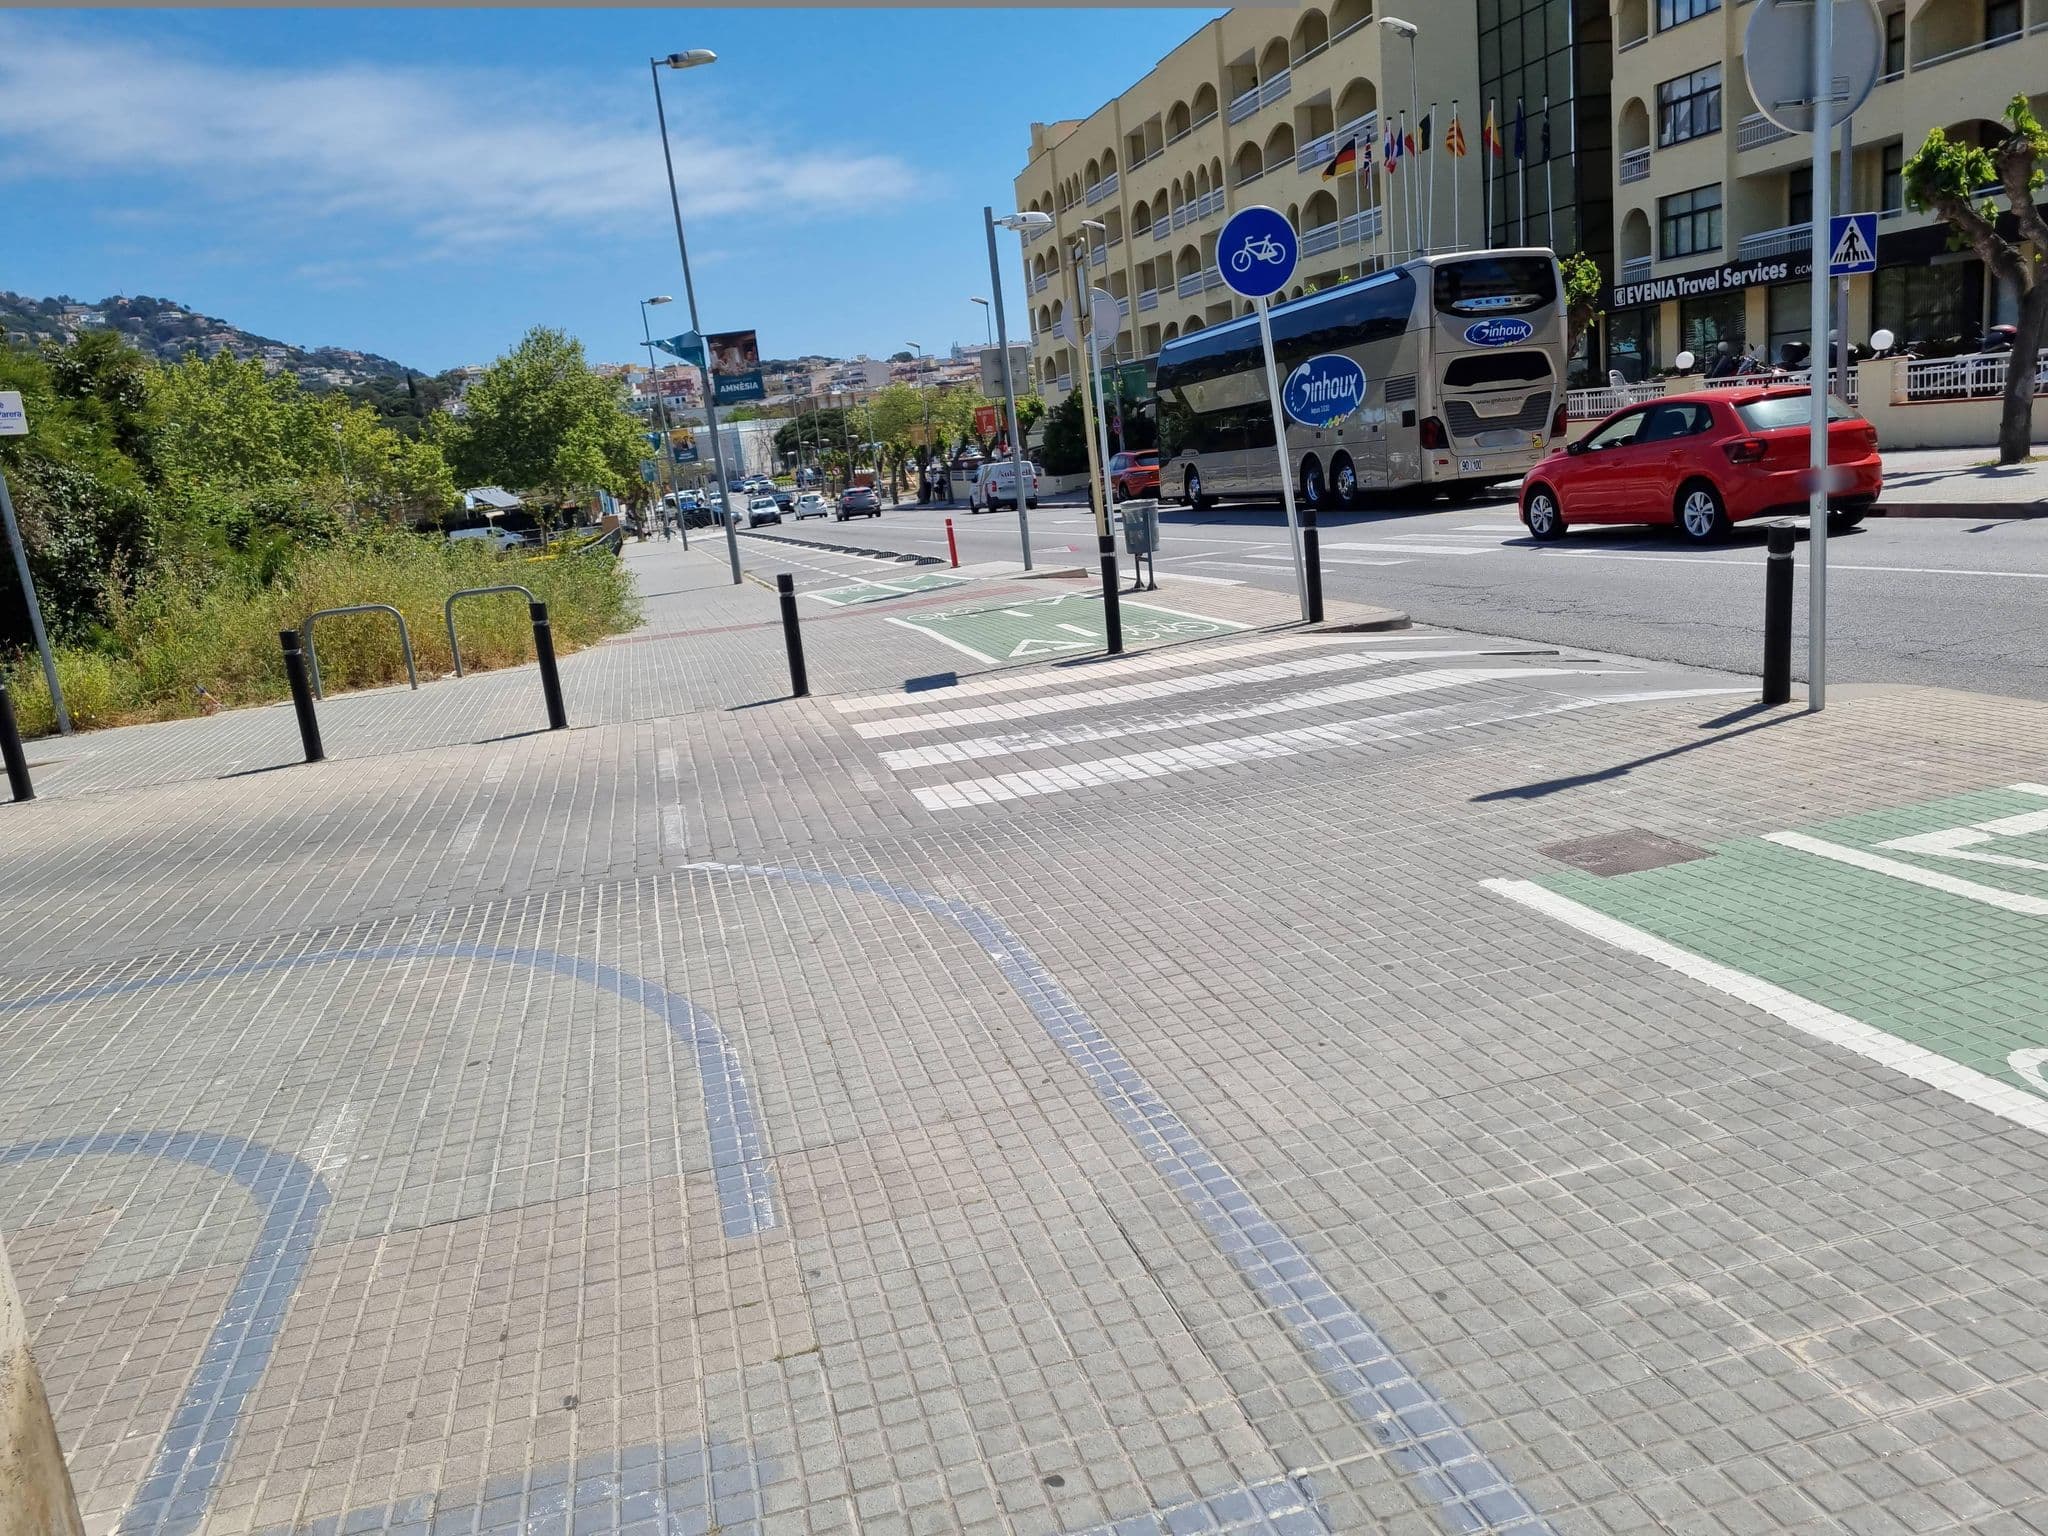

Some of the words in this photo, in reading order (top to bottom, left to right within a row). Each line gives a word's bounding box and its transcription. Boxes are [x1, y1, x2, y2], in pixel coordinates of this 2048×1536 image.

[1627, 279, 1676, 304] EVENIA
[1677, 269, 1719, 295] Travel
[1723, 262, 1787, 287] Services
[1472, 321, 1527, 341] Ginhoux
[720, 381, 759, 393] AMNÈSIA
[1291, 363, 1358, 412] Ginhoux
[1462, 461, 1470, 471] 90
[1473, 459, 1482, 470] 100
